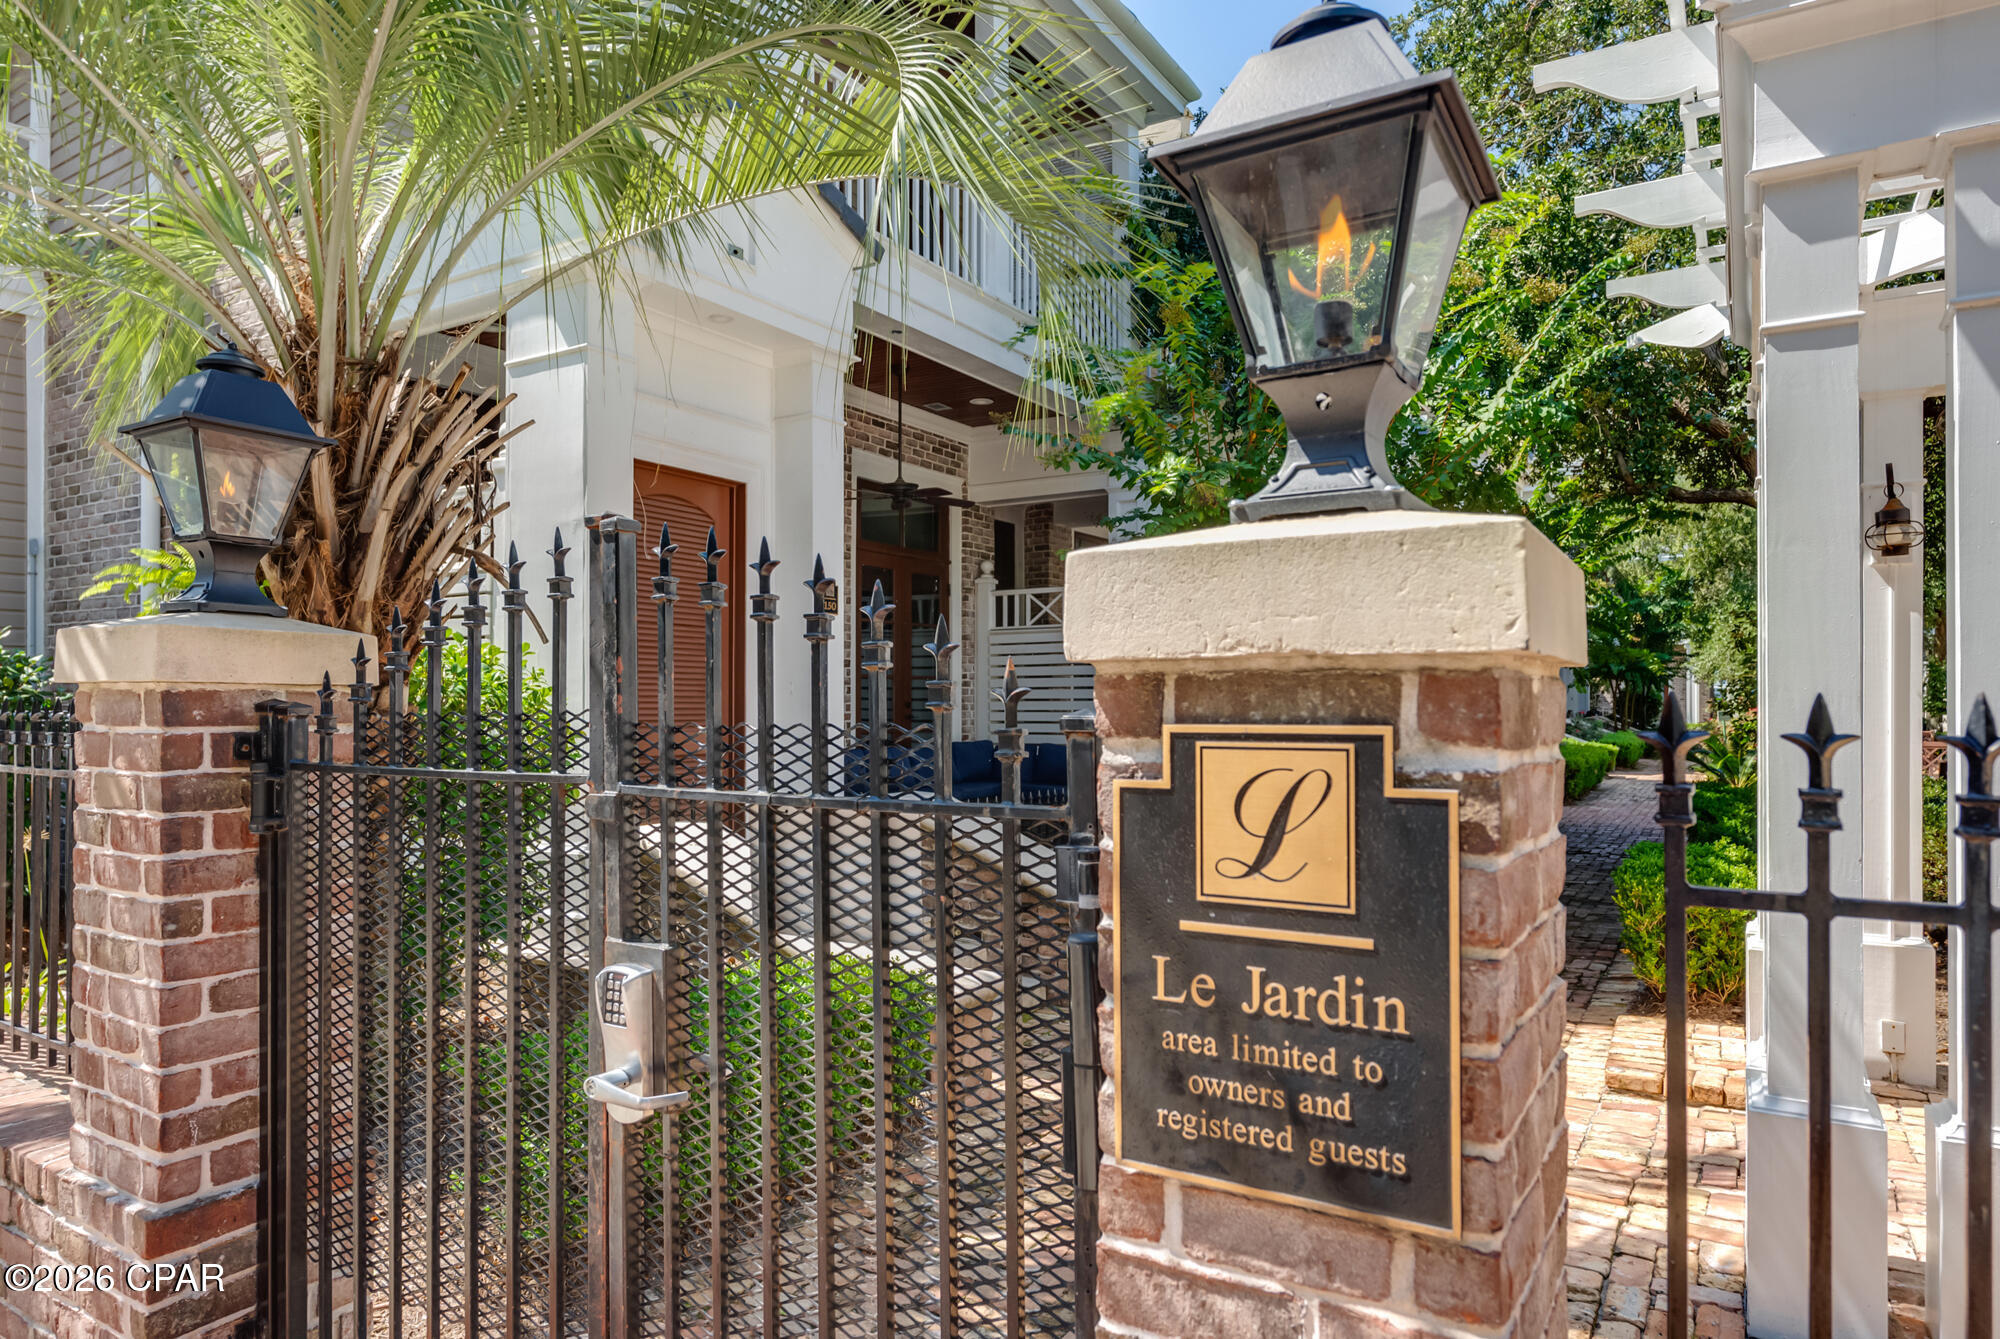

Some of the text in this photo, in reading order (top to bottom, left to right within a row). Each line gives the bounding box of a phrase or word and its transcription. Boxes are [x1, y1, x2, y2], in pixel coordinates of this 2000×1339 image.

[1152, 955, 1410, 1035] Le Jardin
[1162, 1030, 1383, 1083] area limited to
[1188, 1074, 1352, 1121] owners and
[1157, 1107, 1407, 1175] registered guests
